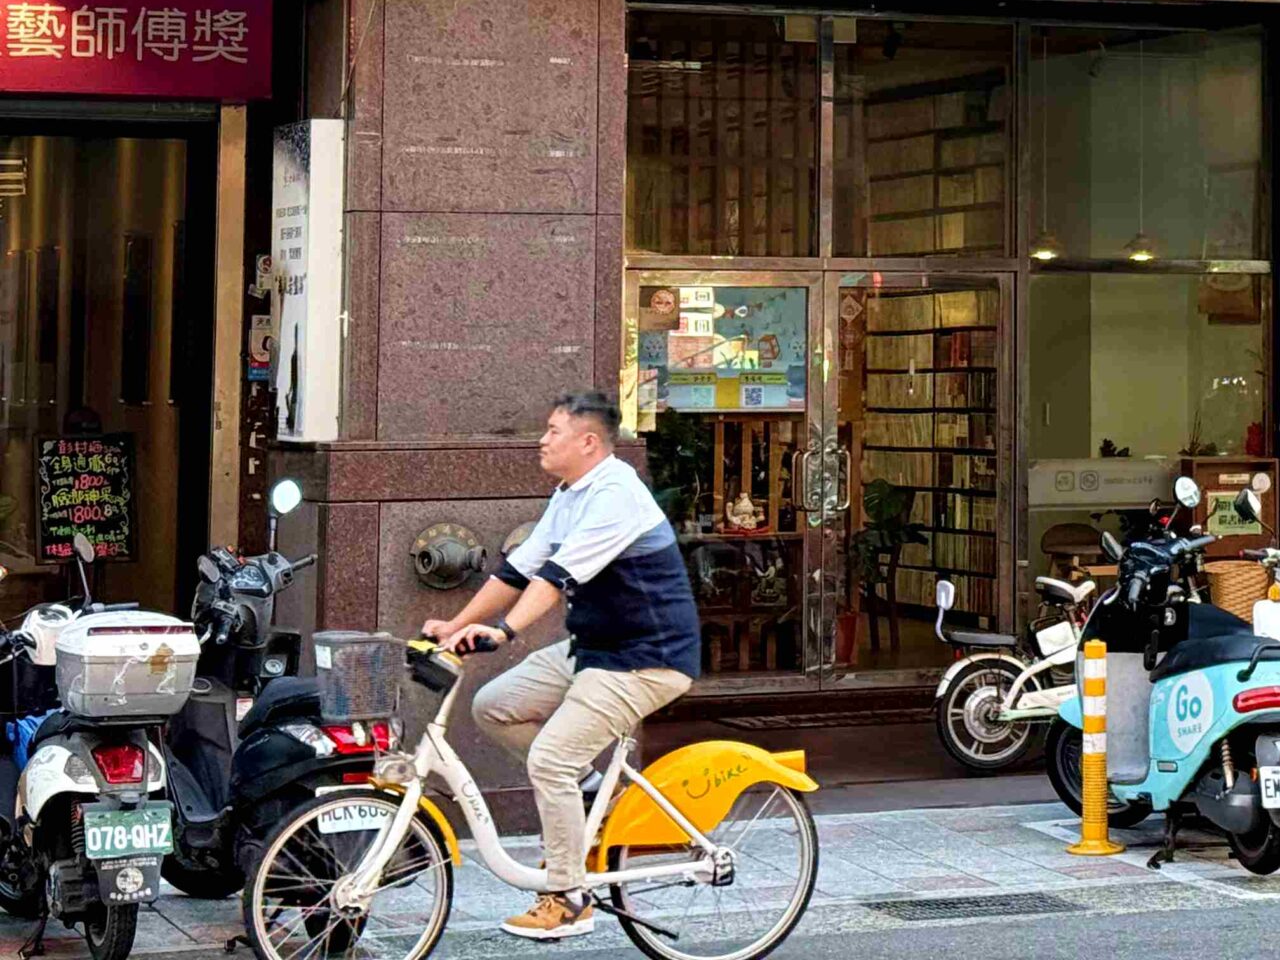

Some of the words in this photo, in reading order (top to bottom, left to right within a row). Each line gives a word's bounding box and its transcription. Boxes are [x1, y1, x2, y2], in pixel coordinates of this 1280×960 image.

[0, 2, 249, 63] 藝師傅獎
[1175, 684, 1203, 722] Go
